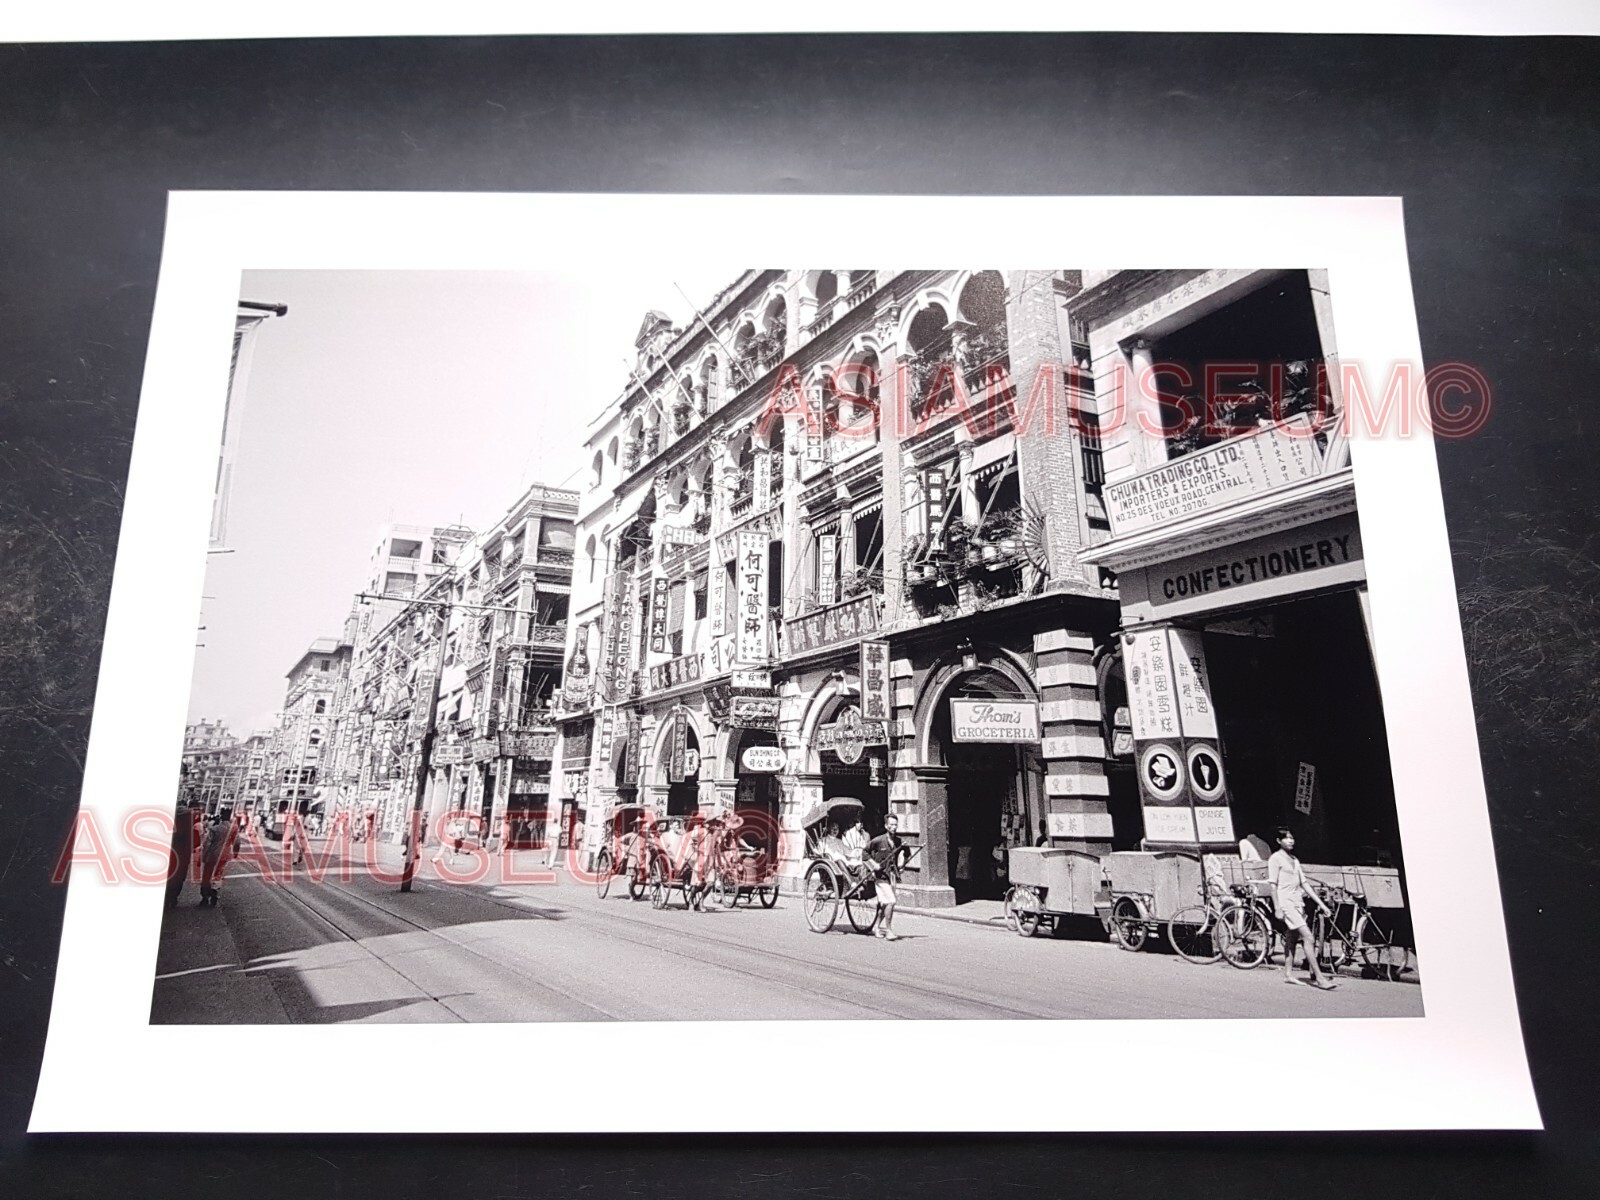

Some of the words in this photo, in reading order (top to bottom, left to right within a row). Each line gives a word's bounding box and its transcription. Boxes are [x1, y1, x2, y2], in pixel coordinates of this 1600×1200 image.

[1145, 462, 1192, 490] TRADING
[1215, 446, 1241, 466] LTD.
[1120, 487, 1168, 511] IMPORTERS
[1173, 484, 1178, 494] &
[1182, 468, 1230, 490] EXPORTS.
[1138, 505, 1152, 516] DES
[1154, 496, 1180, 510] VOEUX
[1152, 512, 1165, 521] TEL
[1163, 536, 1350, 600] CONFECTIONERY
[615, 622, 630, 690] CHEONG
[969, 704, 1022, 725] Thom's
[958, 727, 1036, 740] GROCETERIA
[1199, 810, 1224, 818] ORANGE
[1206, 826, 1226, 834] JUICE
